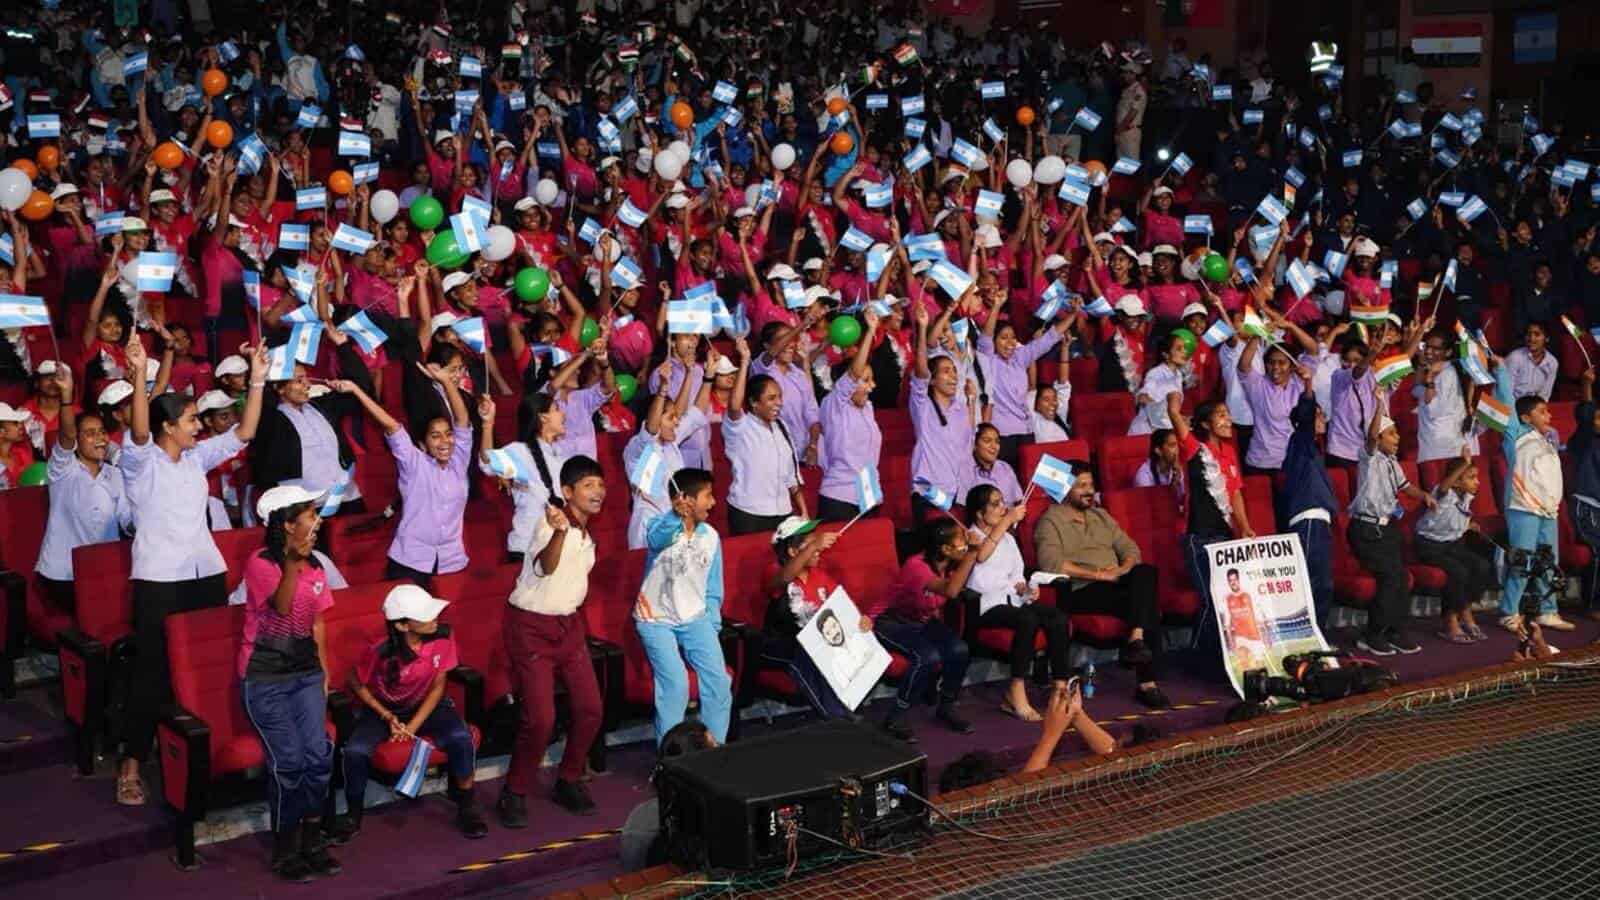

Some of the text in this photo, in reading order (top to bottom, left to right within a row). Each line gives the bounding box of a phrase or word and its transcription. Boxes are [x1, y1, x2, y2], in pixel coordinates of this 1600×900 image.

[1216, 540, 1293, 566] CHAMPION
[1278, 565, 1296, 576] YOU
[1276, 580, 1293, 593] SIR
